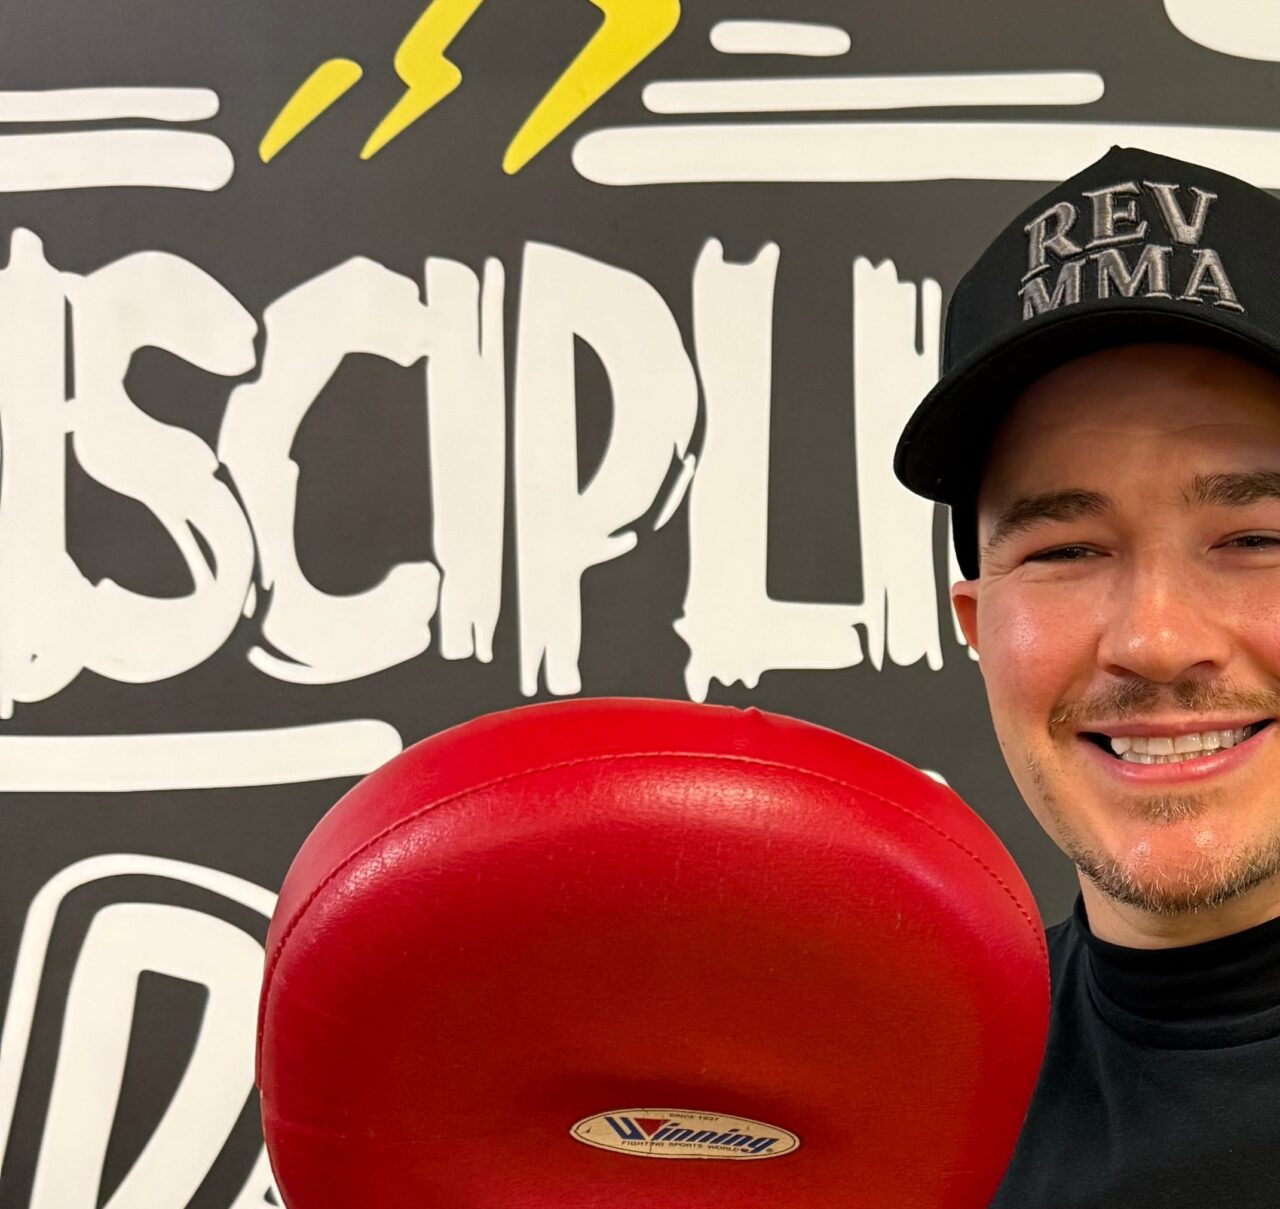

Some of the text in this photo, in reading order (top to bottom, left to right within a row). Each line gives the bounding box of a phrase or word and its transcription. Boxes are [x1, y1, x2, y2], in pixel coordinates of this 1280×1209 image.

[1020, 180, 1218, 284] REV
[1017, 244, 1247, 321] MMA
[604, 1116, 780, 1154] Winning
